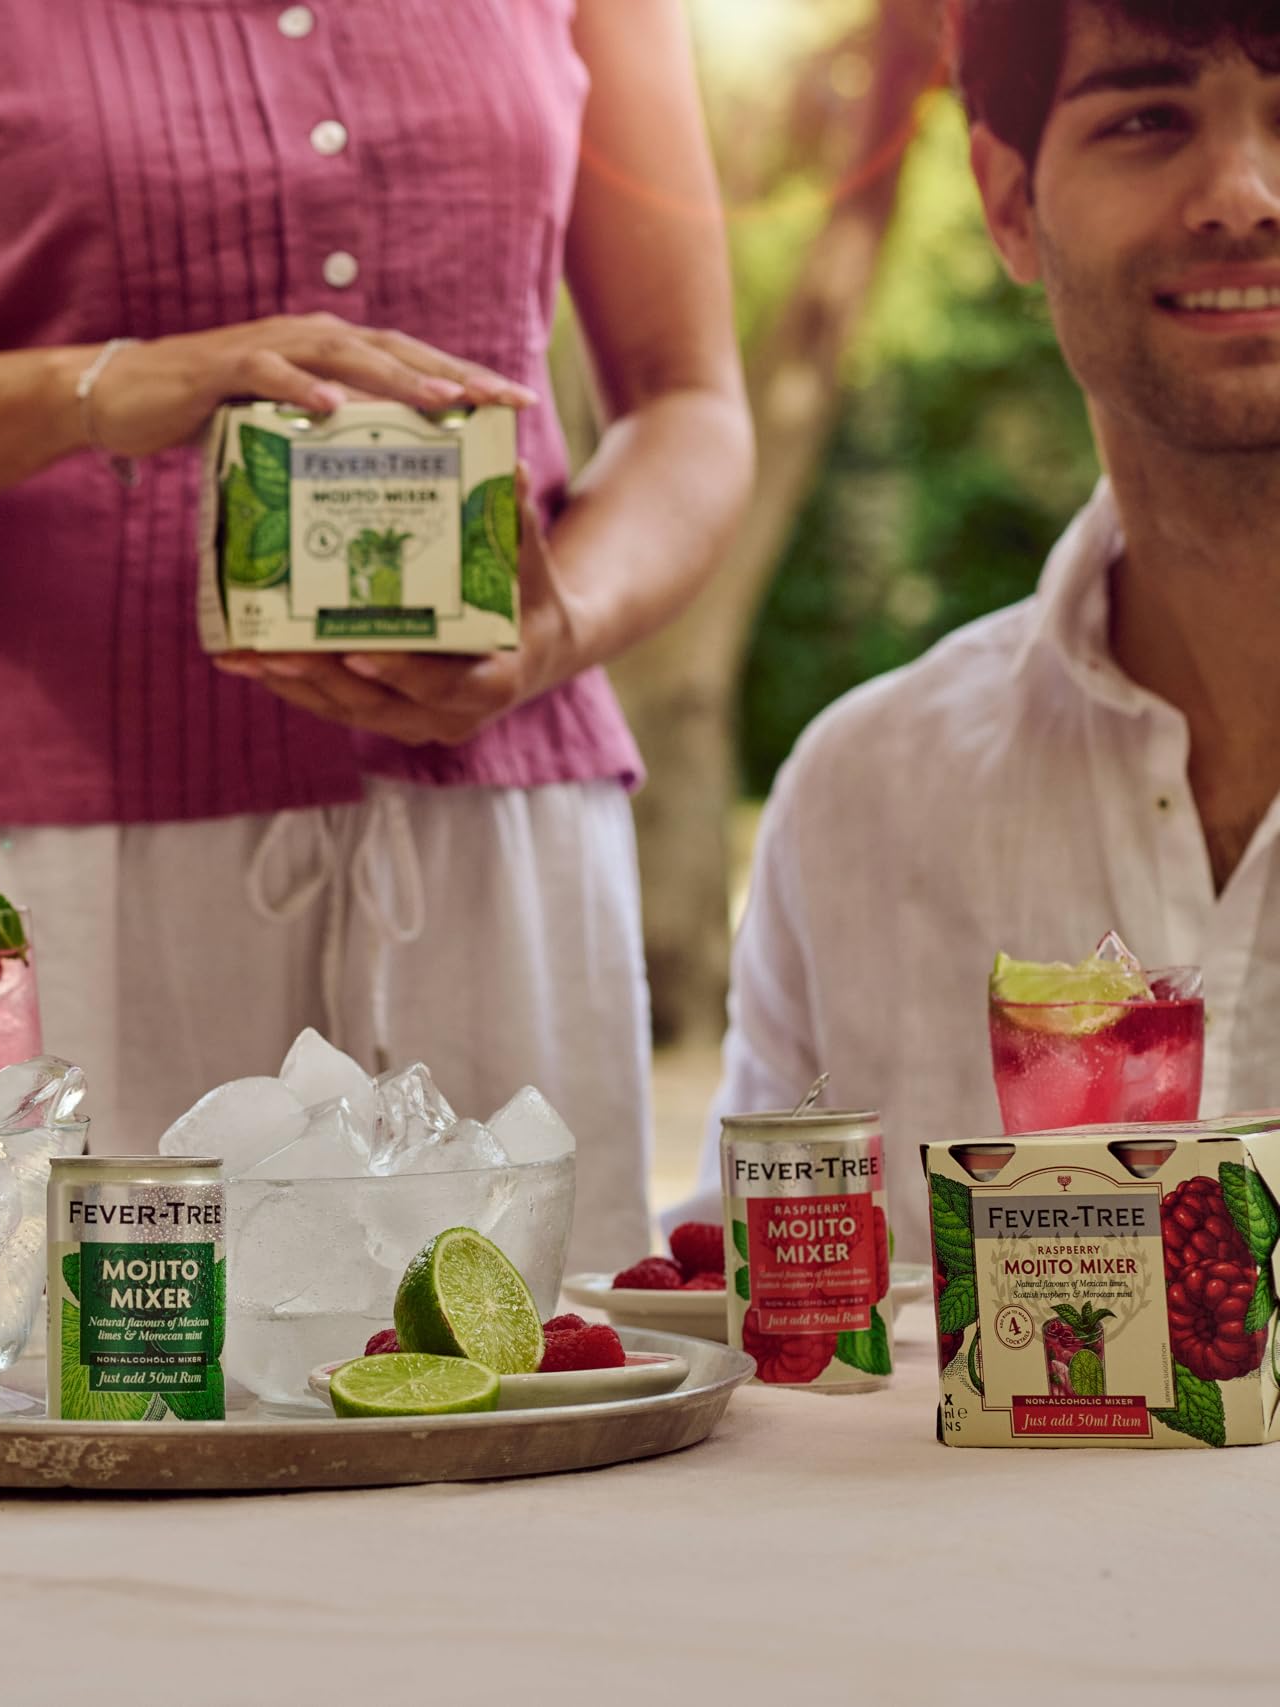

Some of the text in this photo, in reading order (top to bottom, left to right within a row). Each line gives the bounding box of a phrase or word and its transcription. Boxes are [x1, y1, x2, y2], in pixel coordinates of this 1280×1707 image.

[304, 453, 447, 474] FEVER-TREE
[735, 1156, 879, 1181] FEVER-TREE
[69, 1201, 221, 1225] FEVER-TREE
[774, 1203, 847, 1216] RASPBERRY
[989, 1206, 1145, 1229] FEVER-TREE
[768, 1217, 856, 1241] MOJITO
[776, 1243, 849, 1264] MIXER
[1038, 1245, 1101, 1255] RASPBERRY
[102, 1260, 199, 1283] MOJITO
[1004, 1258, 1138, 1277] MOJITO MIXER
[1015, 1280, 1042, 1288] Natural
[1041, 1280, 1070, 1291] flavours
[1070, 1280, 1079, 1290] of
[1078, 1280, 1108, 1288] Mexican
[110, 1288, 193, 1309] MIXER
[1013, 1290, 1133, 1300] Scottish raspberry & Moroccan mint
[88, 1316, 209, 1330] Natural flavours of Mexican
[767, 1314, 788, 1330] Just
[789, 1313, 811, 1326] add
[1009, 1316, 1022, 1336] 4
[98, 1330, 203, 1341] limes & Moroccan mint
[96, 1356, 202, 1364] NON-ALCOHOLIC MIXER
[96, 1371, 202, 1387] Just add 50ml Rum
[1022, 1413, 1141, 1430] Just add 50ml Rum
